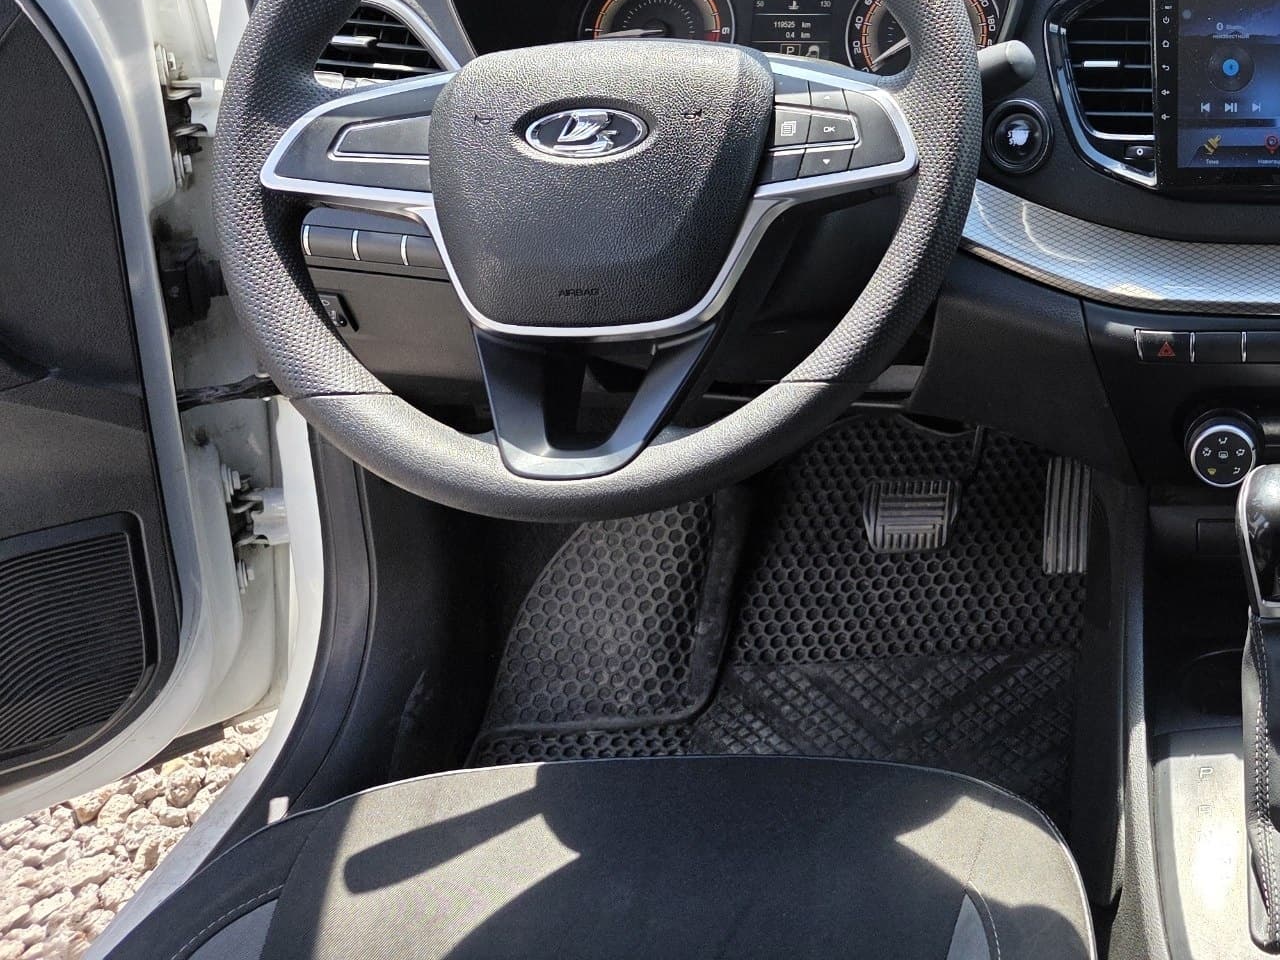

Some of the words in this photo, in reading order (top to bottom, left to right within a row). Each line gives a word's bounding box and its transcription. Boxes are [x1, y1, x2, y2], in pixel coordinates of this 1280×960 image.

[756, 0, 765, 8] 50
[820, 0, 831, 8] 130
[801, 21, 812, 29] km
[854, 15, 864, 30] 40
[987, 14, 996, 32] 180
[721, 27, 730, 35] 6
[800, 31, 811, 39] km
[786, 46, 795, 56] P
[853, 40, 862, 54] 20
[1199, 766, 1214, 780] P
